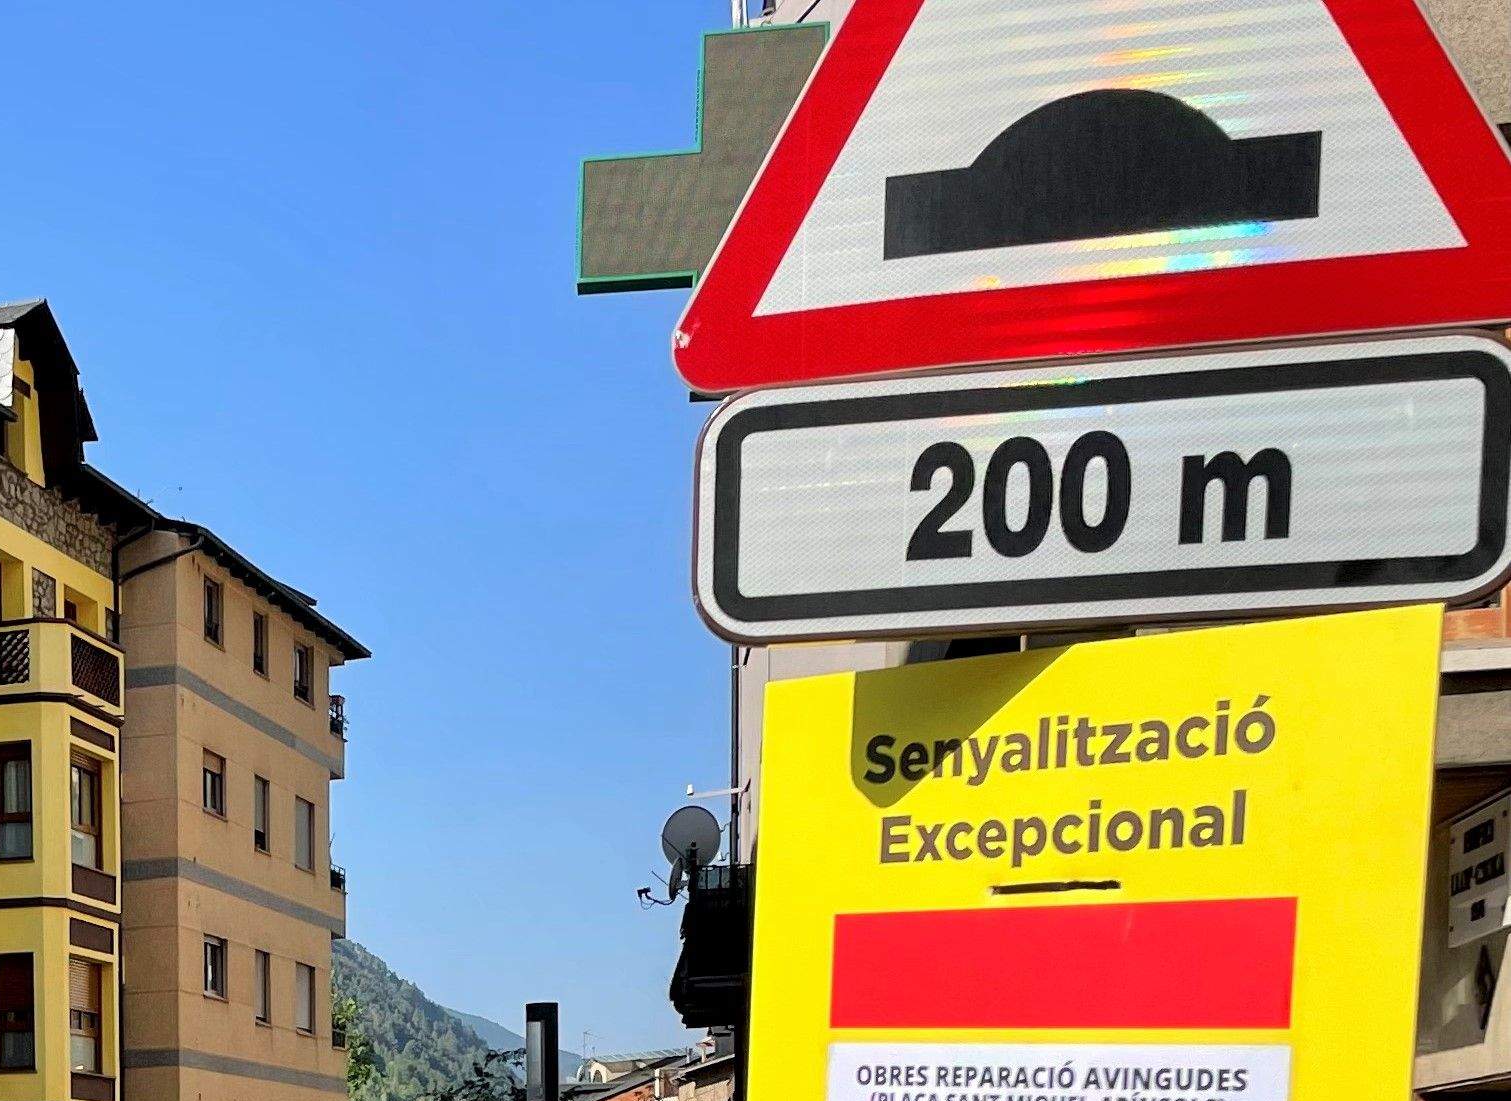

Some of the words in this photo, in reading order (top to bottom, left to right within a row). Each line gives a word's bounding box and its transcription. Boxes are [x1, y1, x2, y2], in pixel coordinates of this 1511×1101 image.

[906, 430, 1131, 561] 200
[1179, 448, 1292, 545] m
[863, 695, 1275, 786] Senyalització
[880, 789, 1247, 868] Excepcional
[856, 1065, 928, 1087] OBRES
[936, 1061, 1074, 1090] REPARACIÓ
[1082, 1067, 1248, 1092] AVINGUDES
